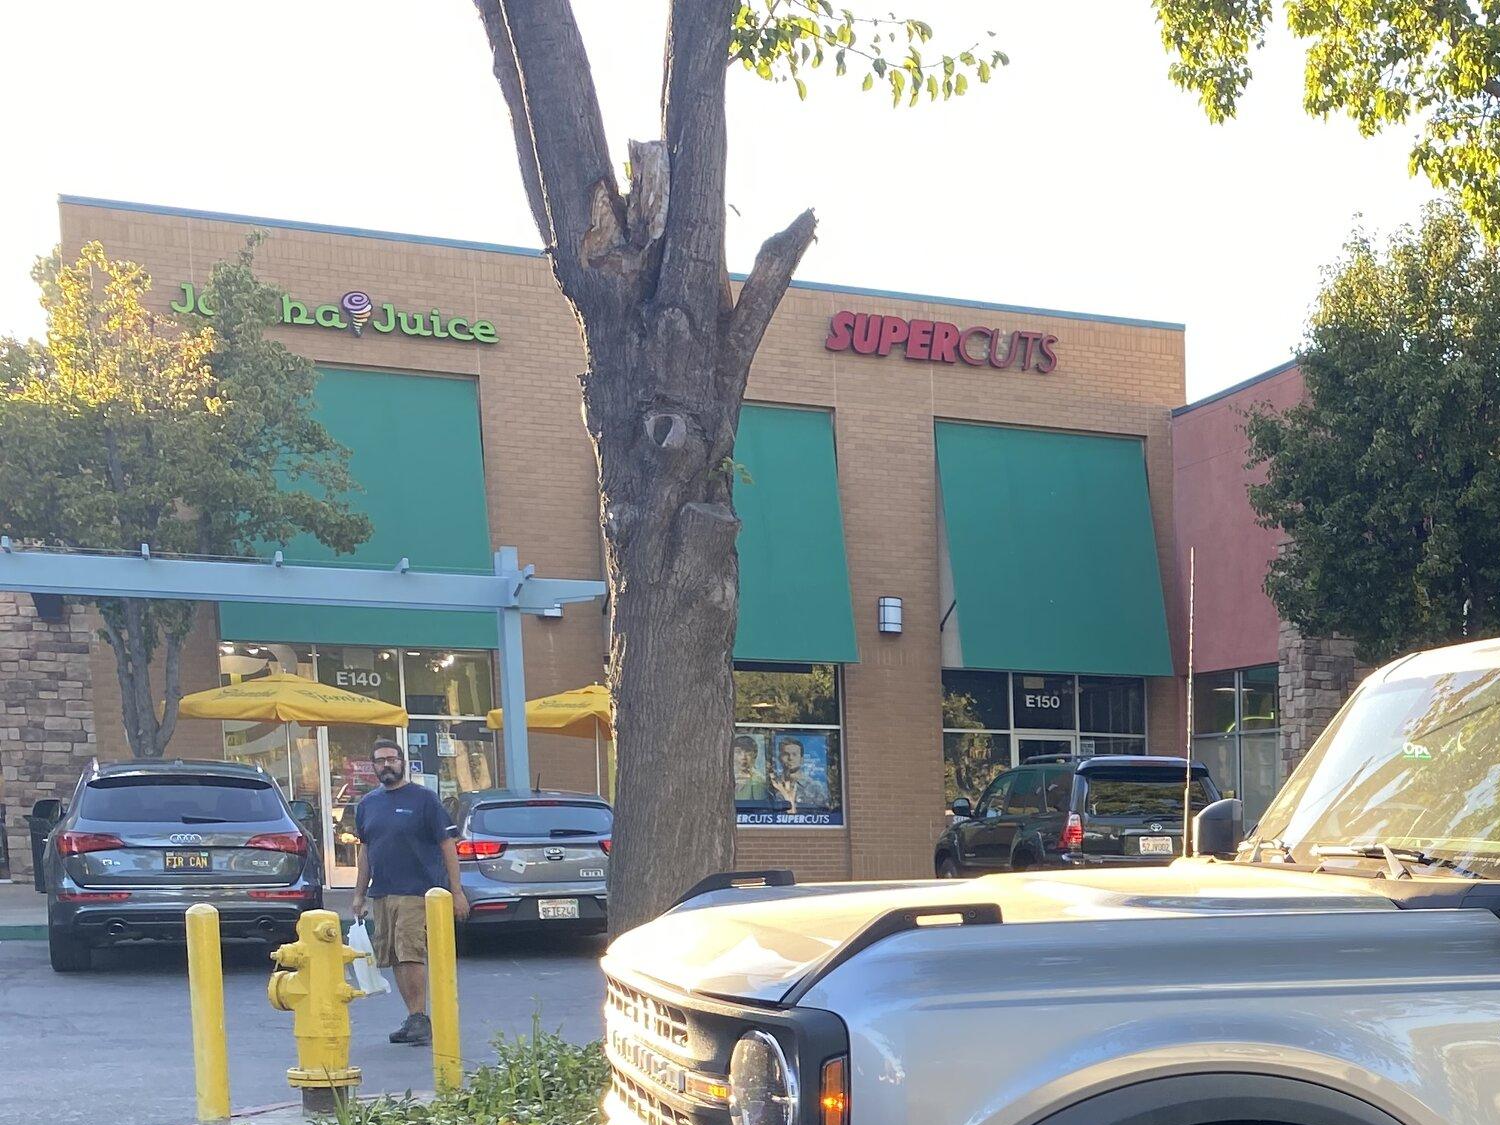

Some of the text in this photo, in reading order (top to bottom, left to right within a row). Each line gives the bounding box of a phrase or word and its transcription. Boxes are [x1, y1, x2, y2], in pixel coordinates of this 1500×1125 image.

[373, 304, 500, 344] Juice
[825, 310, 1059, 373] SUPERCUTS
[336, 671, 382, 687] E140
[1025, 694, 1060, 709] E150
[776, 814, 829, 823] SUPERCUTS
[189, 856, 208, 868] CAN
